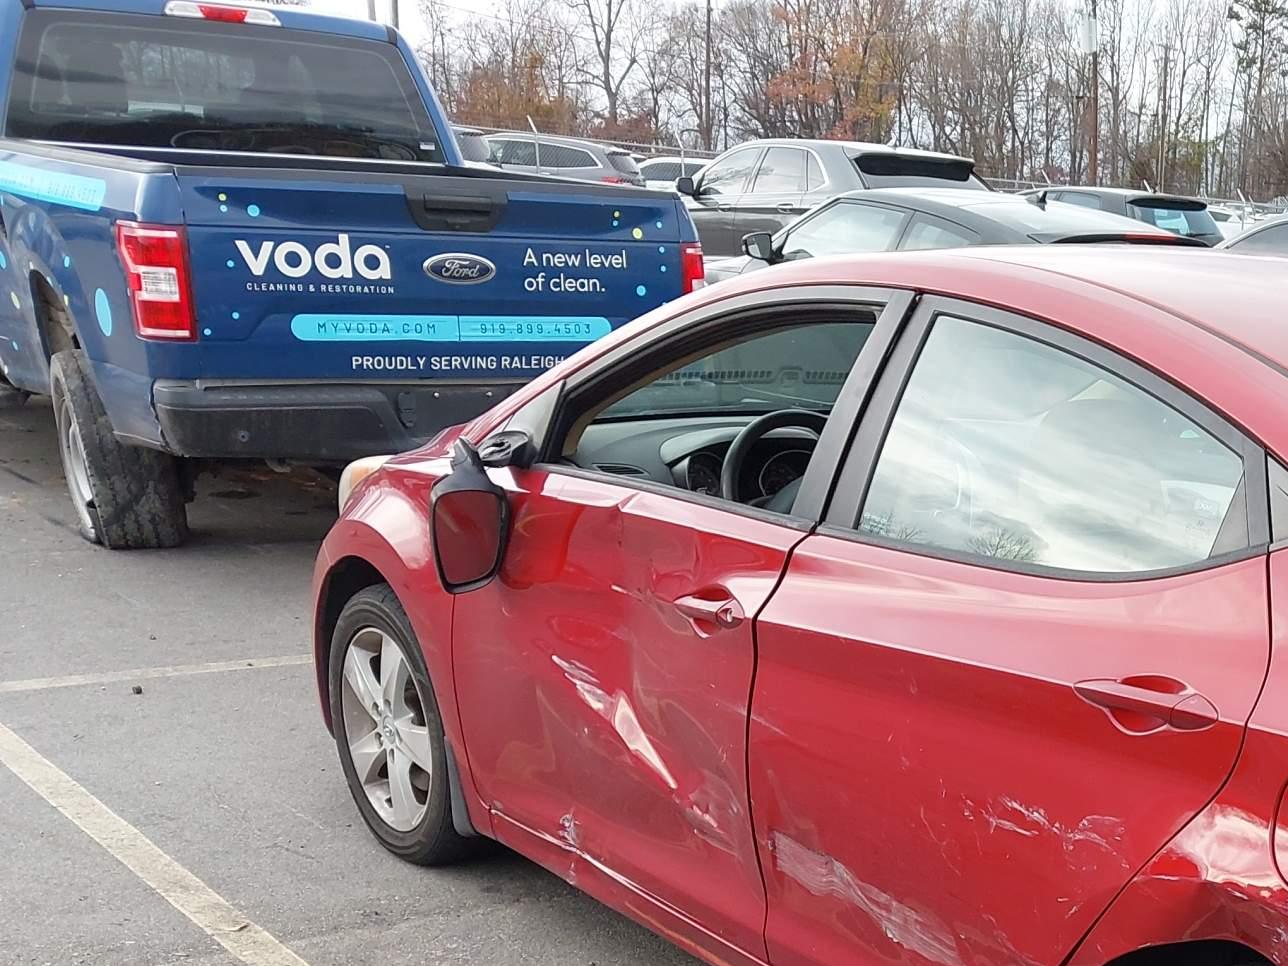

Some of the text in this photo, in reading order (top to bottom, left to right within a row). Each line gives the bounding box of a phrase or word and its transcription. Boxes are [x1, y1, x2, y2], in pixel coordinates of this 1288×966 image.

[234, 233, 392, 280] voda
[523, 247, 627, 269] A new level
[441, 258, 480, 278] Ford
[246, 282, 395, 295] CLEANING & RESTORATION
[524, 272, 606, 293] of clean.
[317, 321, 437, 336] MYVODA.COM
[480, 322, 592, 336] 919.899.4503
[351, 355, 426, 370] PROUDLY
[430, 355, 497, 370] SERVING
